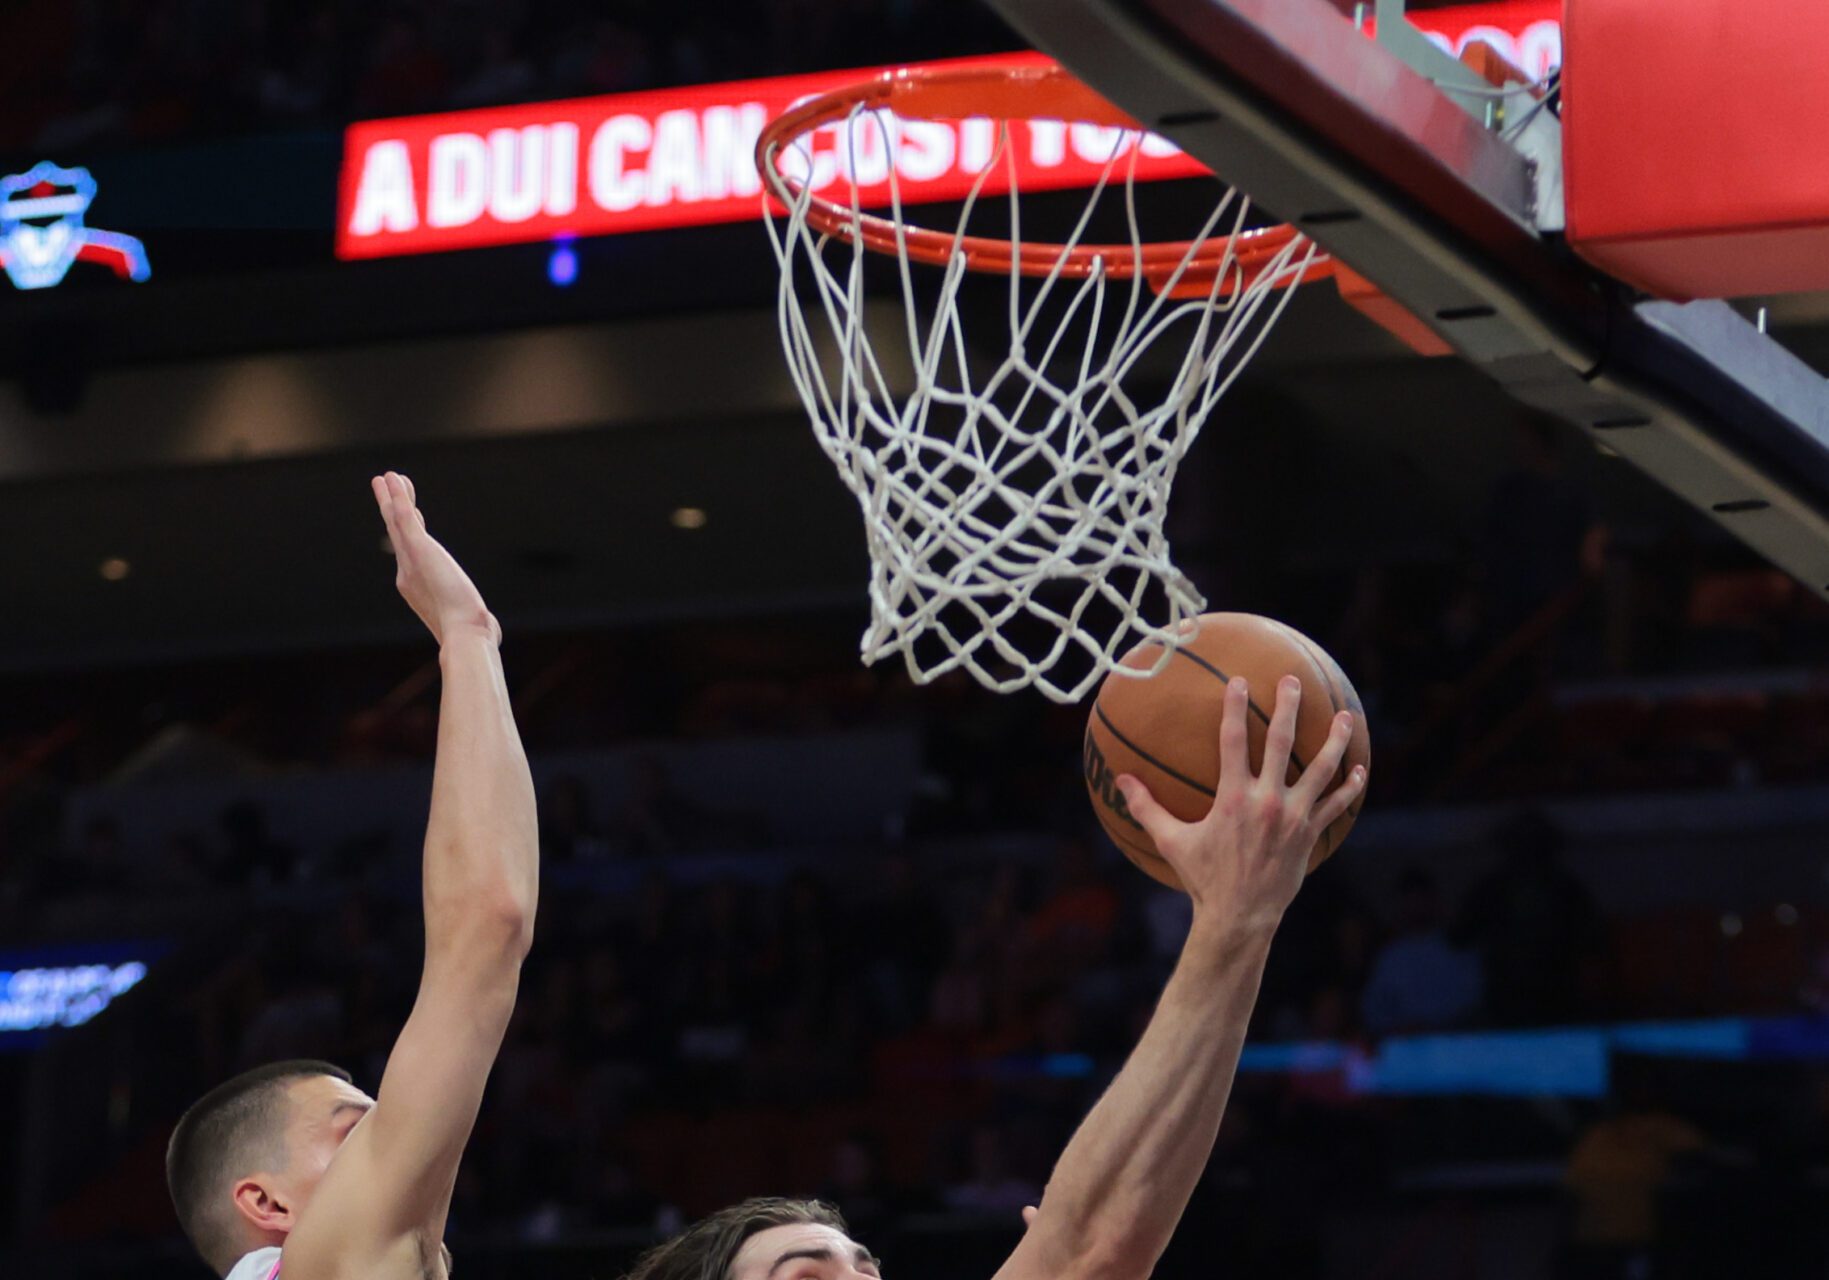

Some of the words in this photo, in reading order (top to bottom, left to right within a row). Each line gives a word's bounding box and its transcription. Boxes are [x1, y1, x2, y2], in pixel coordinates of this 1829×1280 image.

[350, 139, 418, 236] A
[427, 122, 580, 228] DUI
[588, 103, 768, 212] CAN
